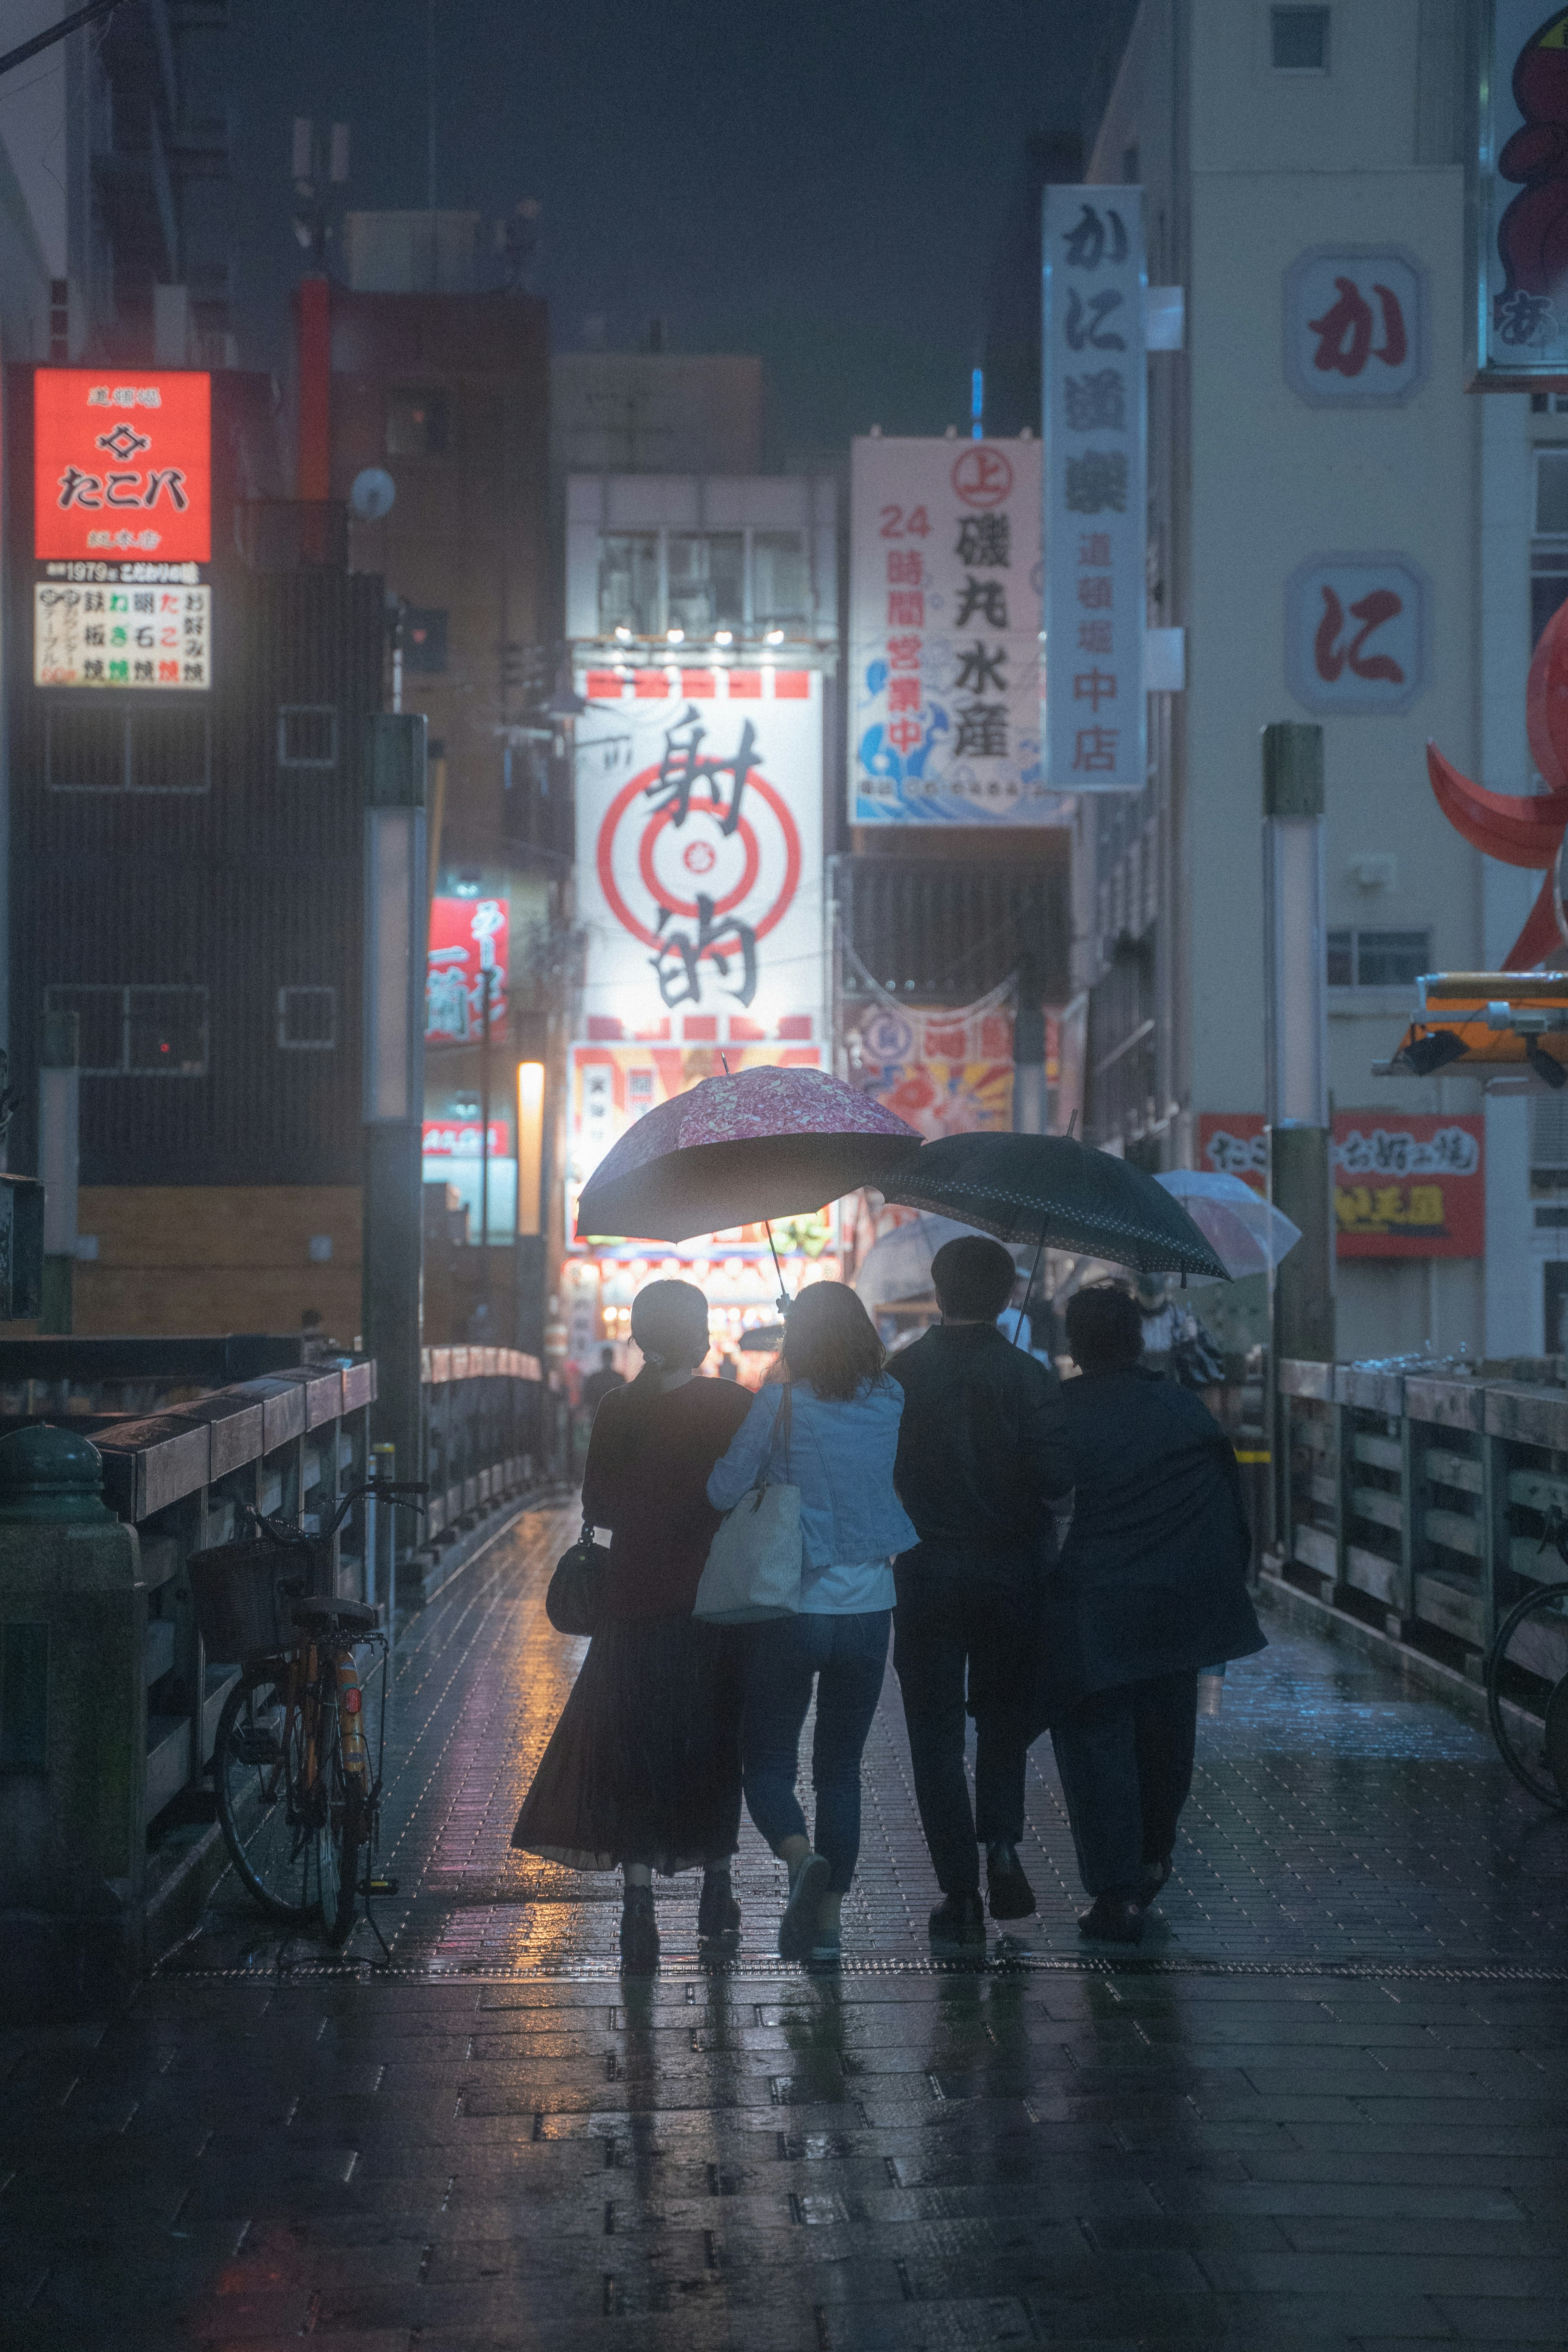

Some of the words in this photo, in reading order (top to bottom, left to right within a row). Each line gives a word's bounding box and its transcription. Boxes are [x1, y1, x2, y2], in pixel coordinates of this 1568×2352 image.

[57, 466, 189, 512] たこ八
[135, 592, 155, 683] 明石焼
[158, 593, 180, 683] たこ焼
[879, 504, 932, 755] 24時間営業中
[956, 512, 1010, 759] 磯丸水産
[644, 703, 764, 1008] 射的
